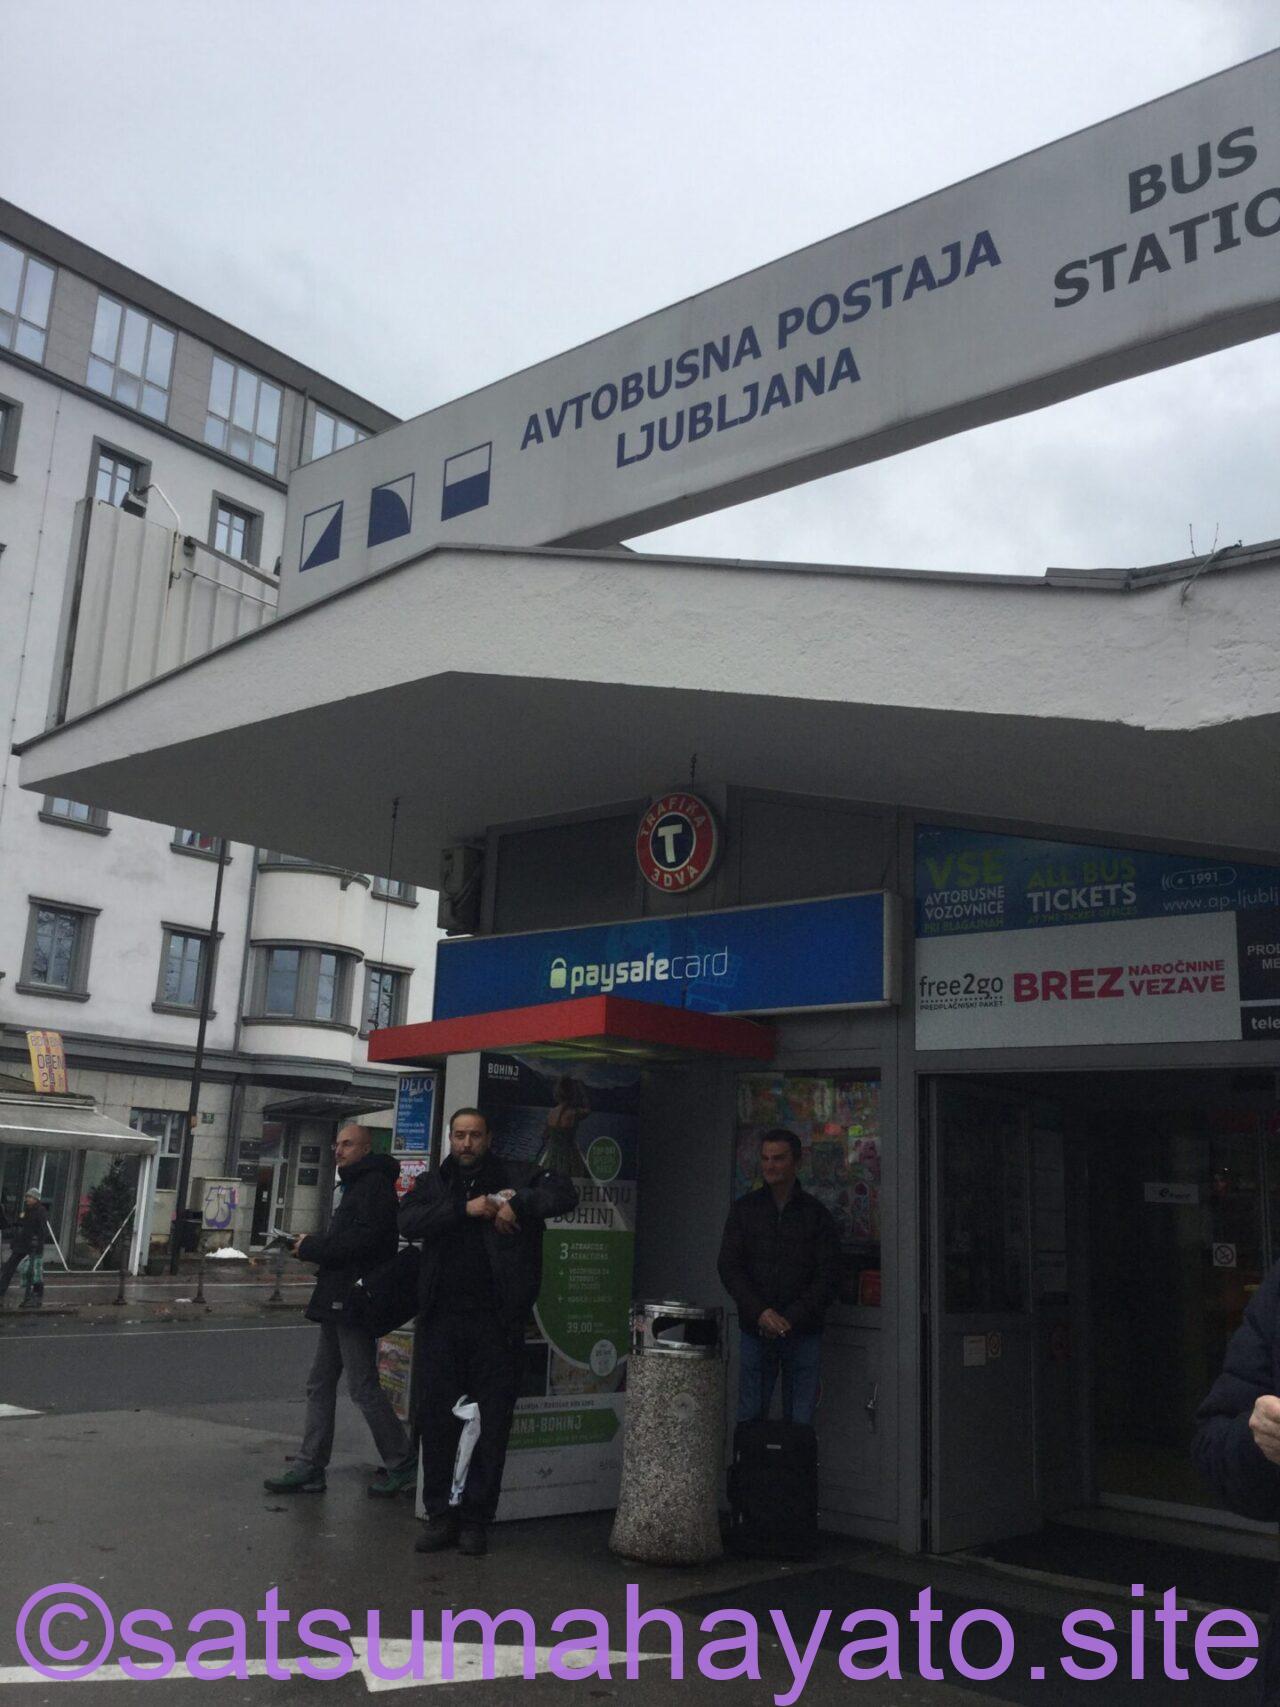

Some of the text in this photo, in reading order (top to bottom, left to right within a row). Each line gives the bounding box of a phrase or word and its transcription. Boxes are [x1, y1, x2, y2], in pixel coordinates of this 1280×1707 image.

[1128, 126, 1258, 214] BUS
[520, 230, 1002, 451] AVTOBUSNA POSTAJA
[616, 346, 861, 469] LJUBLJANA
[640, 796, 706, 837] TRAFIKA
[657, 822, 683, 864] T
[650, 864, 700, 887] 3DVA
[926, 848, 1006, 890] VSE
[1025, 854, 1137, 890] ALL BUS
[1191, 871, 1218, 886] 1991
[924, 885, 1006, 906] AVTOBUSNE
[1026, 881, 1137, 913] TICKETS
[924, 901, 1005, 921] VOZOVNICE
[571, 945, 728, 995] paysafecard
[1129, 959, 1225, 977] NAROČNINE
[920, 973, 1004, 999] free2go
[1013, 966, 1124, 1003] BREZ
[1130, 975, 1225, 996] VEZAVE
[487, 1062, 520, 1077] BOHINJ
[401, 1078, 434, 1092] DELO
[560, 1242, 569, 1260] 3
[566, 1321, 593, 1334] 39,00
[510, 1415, 584, 1435] ANA-BOHINJ
